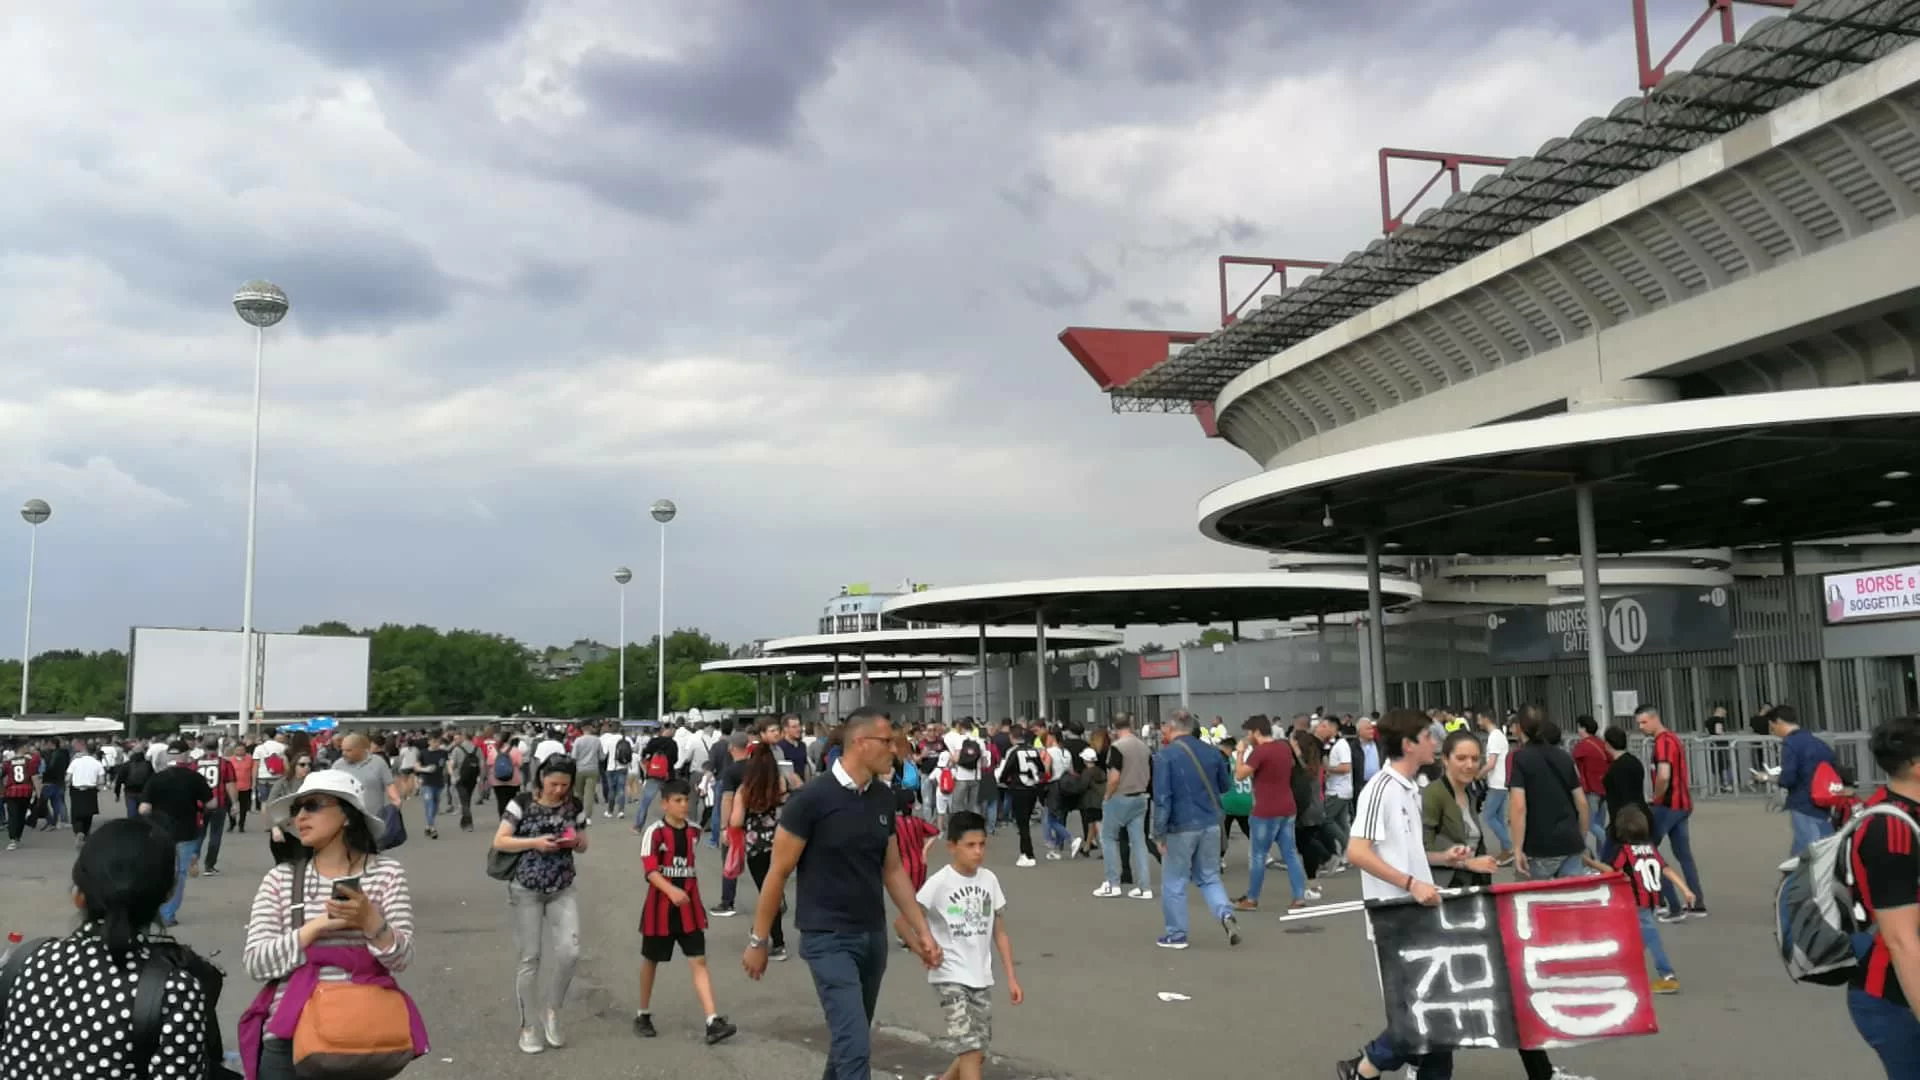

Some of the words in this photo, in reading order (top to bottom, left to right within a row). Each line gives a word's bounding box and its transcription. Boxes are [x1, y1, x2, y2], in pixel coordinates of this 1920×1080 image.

[1856, 574, 1904, 594] BORSE
[1908, 577, 1916, 589] e
[1849, 596, 1899, 611] SOGGETTI
[1902, 595, 1911, 606] A
[1546, 606, 1606, 633] INGRESO
[1614, 605, 1642, 645] 10
[13, 765, 25, 783] 8
[1017, 750, 1040, 787] 5
[1634, 858, 1661, 892] 10
[1513, 884, 1639, 1047] LUD
